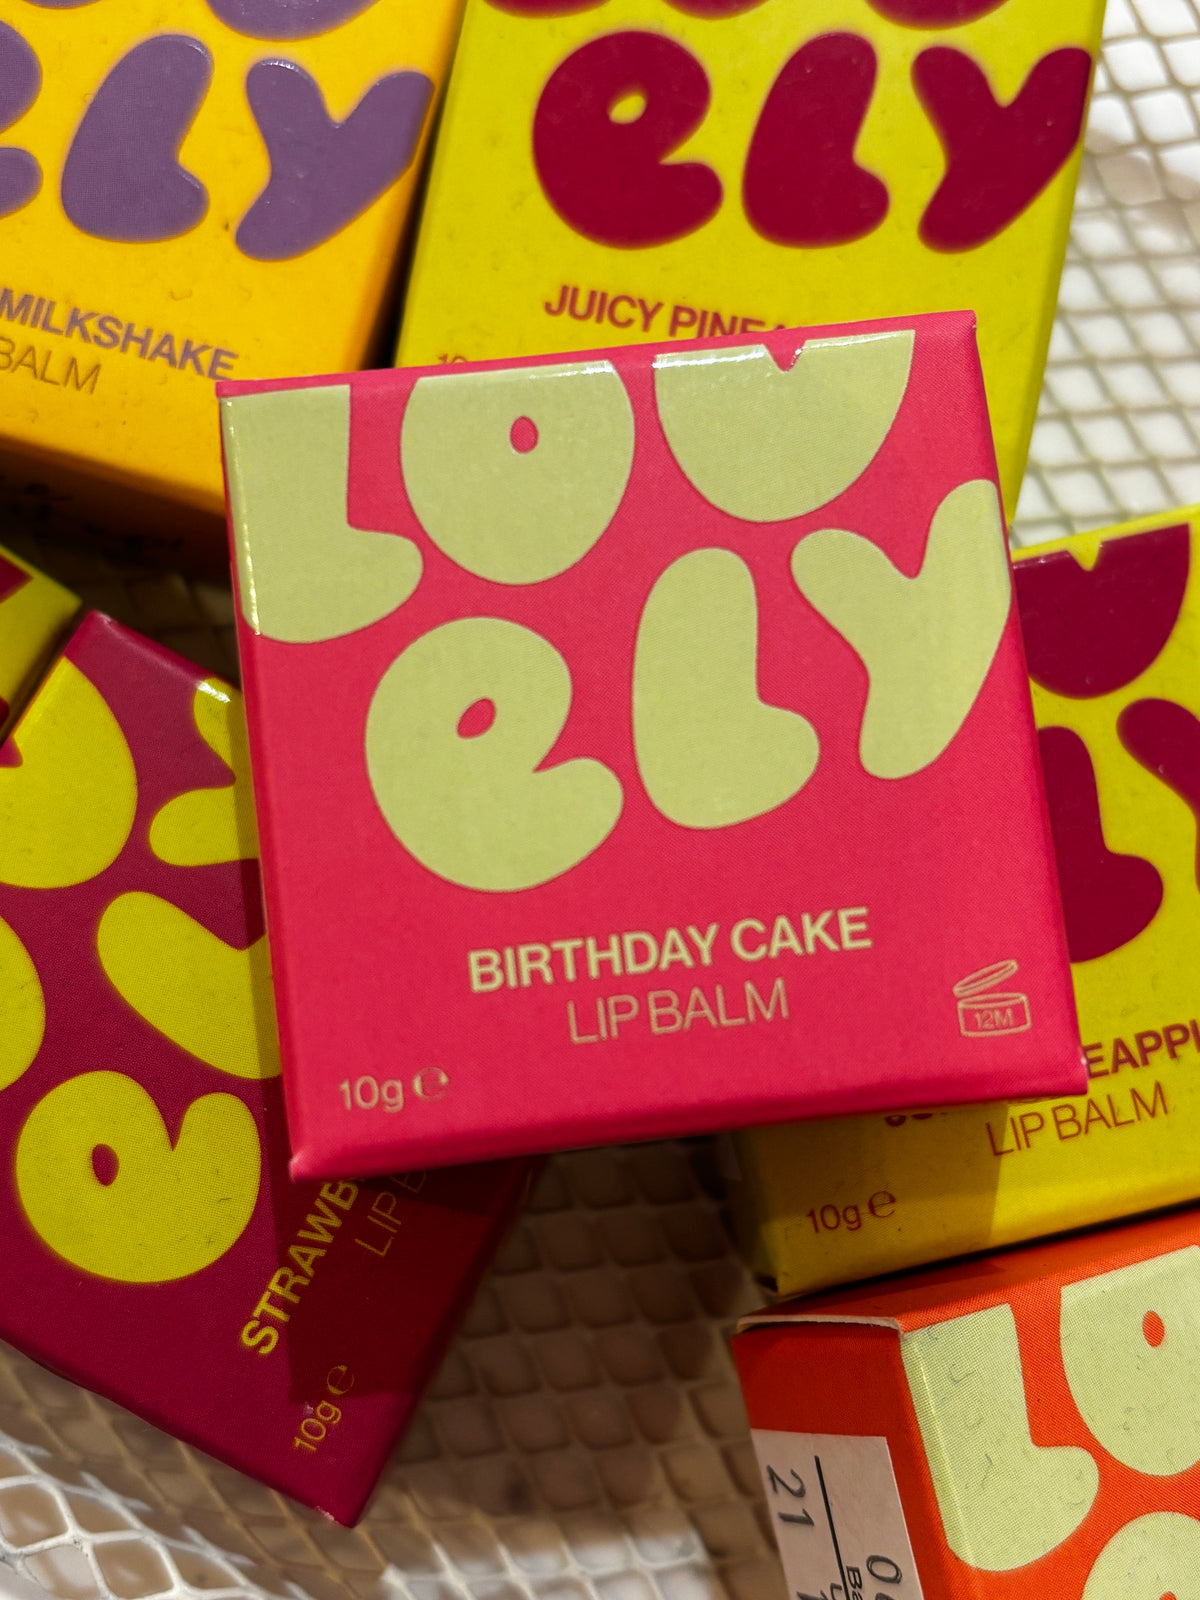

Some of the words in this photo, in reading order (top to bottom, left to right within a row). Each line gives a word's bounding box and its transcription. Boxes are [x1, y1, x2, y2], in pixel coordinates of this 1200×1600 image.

[0, 287, 240, 380] MILKSHAKE
[544, 284, 664, 333] JUICY
[467, 923, 720, 994] BIRTHDAY
[731, 907, 872, 962] CAKE
[567, 993, 640, 1045] LIP
[650, 977, 789, 1037] BALM
[973, 1007, 1014, 1031] 12M
[339, 1074, 404, 1112] 10g
[985, 1111, 1044, 1157] LIP
[1054, 1081, 1168, 1142] BALM
[353, 1191, 402, 1257] LIP
[805, 1202, 863, 1235] 10g
[240, 1176, 366, 1356] STRAWB
[292, 1399, 342, 1454] 10g
